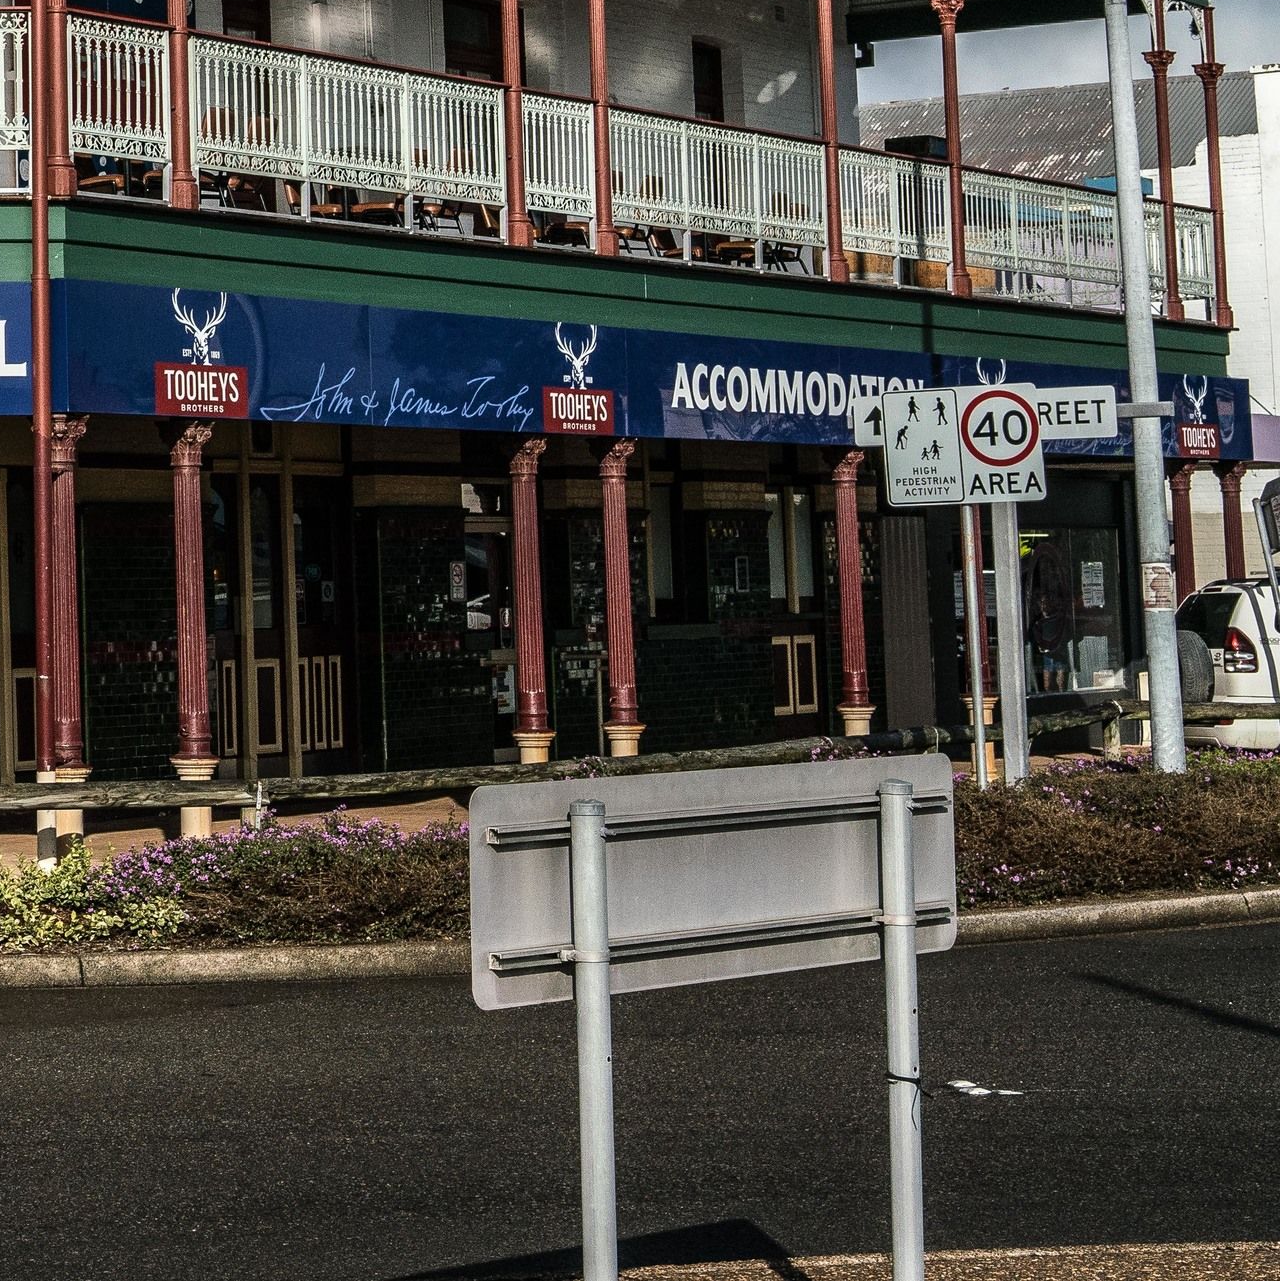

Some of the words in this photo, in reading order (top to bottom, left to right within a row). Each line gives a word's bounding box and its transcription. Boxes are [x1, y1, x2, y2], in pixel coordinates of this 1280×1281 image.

[163, 369, 240, 403] TOOHEYS
[180, 403, 225, 414] BROTHERS
[383, 377, 457, 427] James
[549, 392, 608, 422] TOOHEYS
[1037, 399, 1106, 426] REET
[562, 422, 596, 431] BROTHERS
[972, 408, 1029, 447] 40
[1181, 427, 1216, 449] TOOHEYS
[895, 476, 957, 488] PEDESTRIAN
[912, 466, 938, 476] HIGH
[904, 486, 950, 497] ACTIVITY
[969, 471, 1043, 496] AREA
